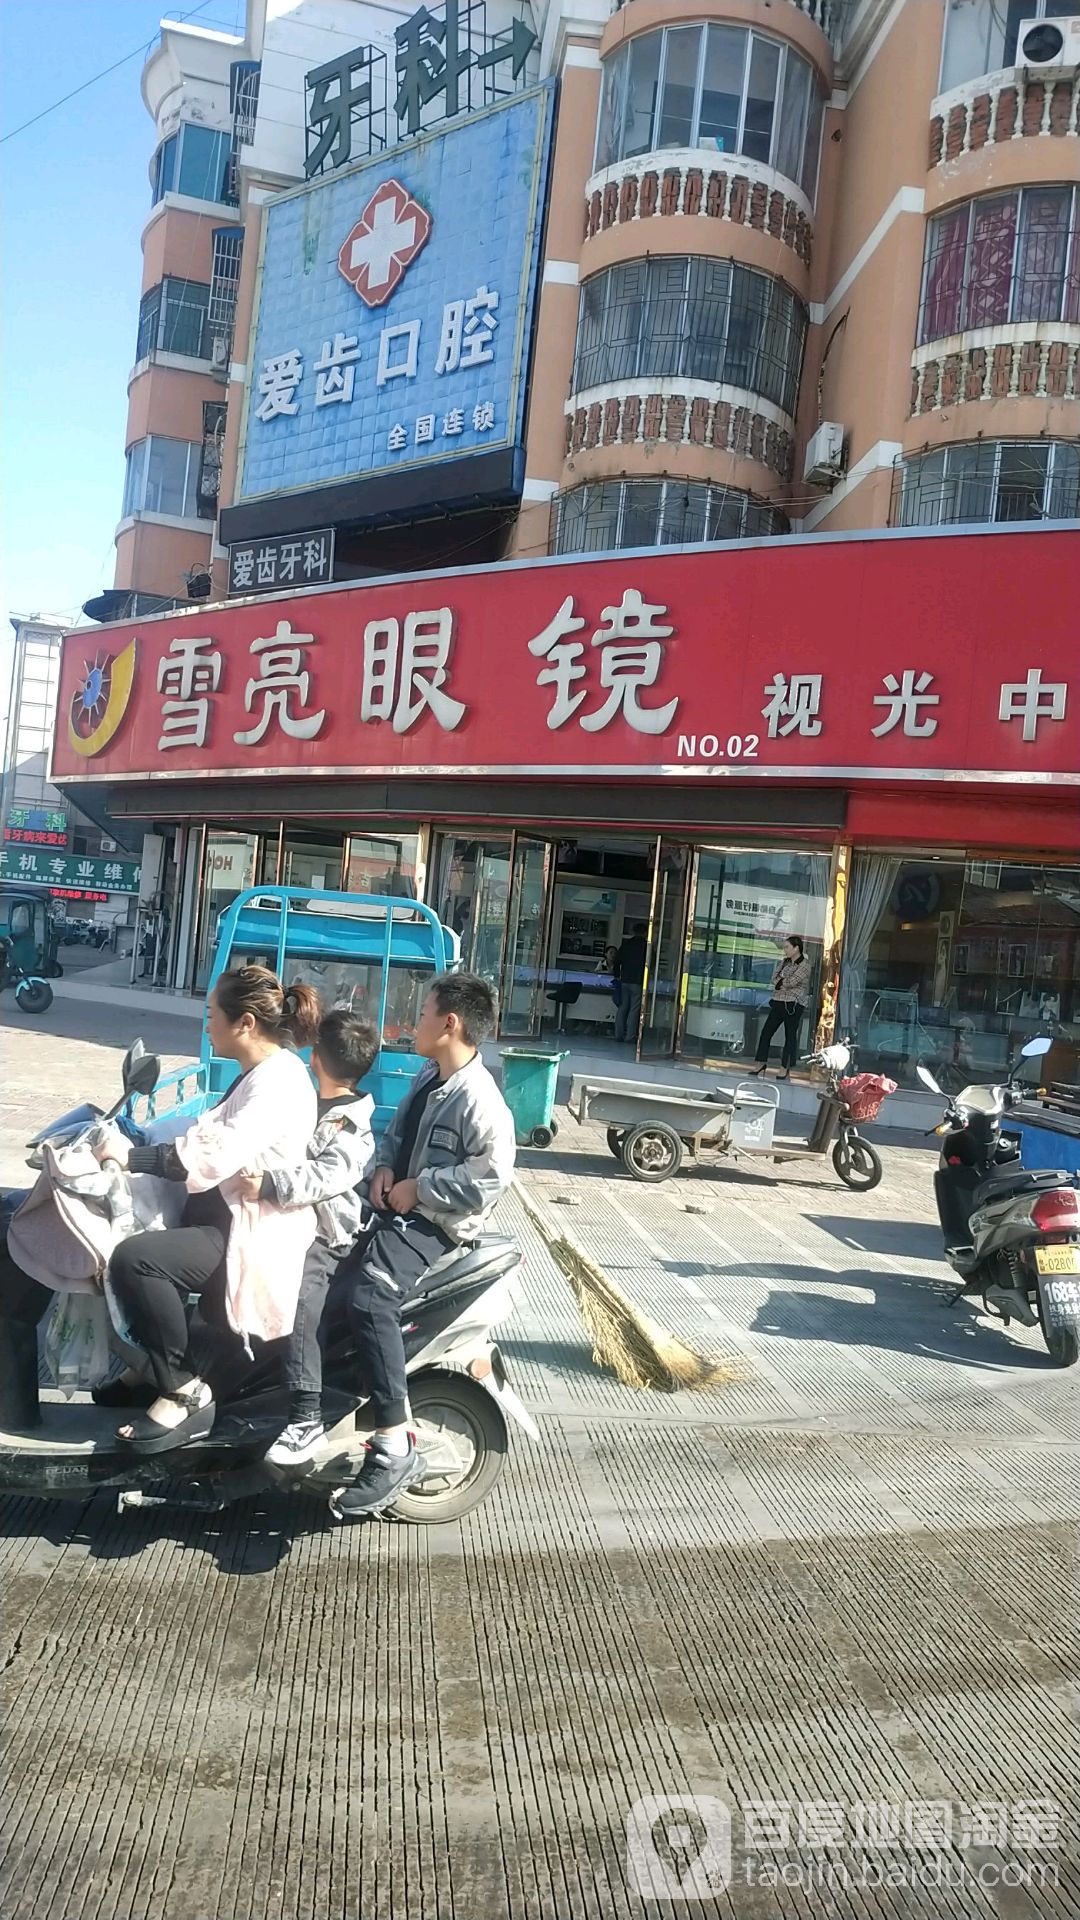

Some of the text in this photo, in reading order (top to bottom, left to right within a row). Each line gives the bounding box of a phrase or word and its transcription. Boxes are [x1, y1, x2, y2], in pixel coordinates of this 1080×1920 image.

[302, 0, 473, 177] 牙科
[255, 285, 499, 423] 爱齿口腔
[386, 402, 496, 451] 全国连锁
[232, 537, 328, 588] 爱齿牙科
[156, 588, 679, 751] 雪亮眼镜
[761, 669, 1069, 741] 视光中
[676, 734, 760, 758] NO.02
[8, 809, 67, 832] 牙科
[1044, 1281, 1080, 1303] 168车
